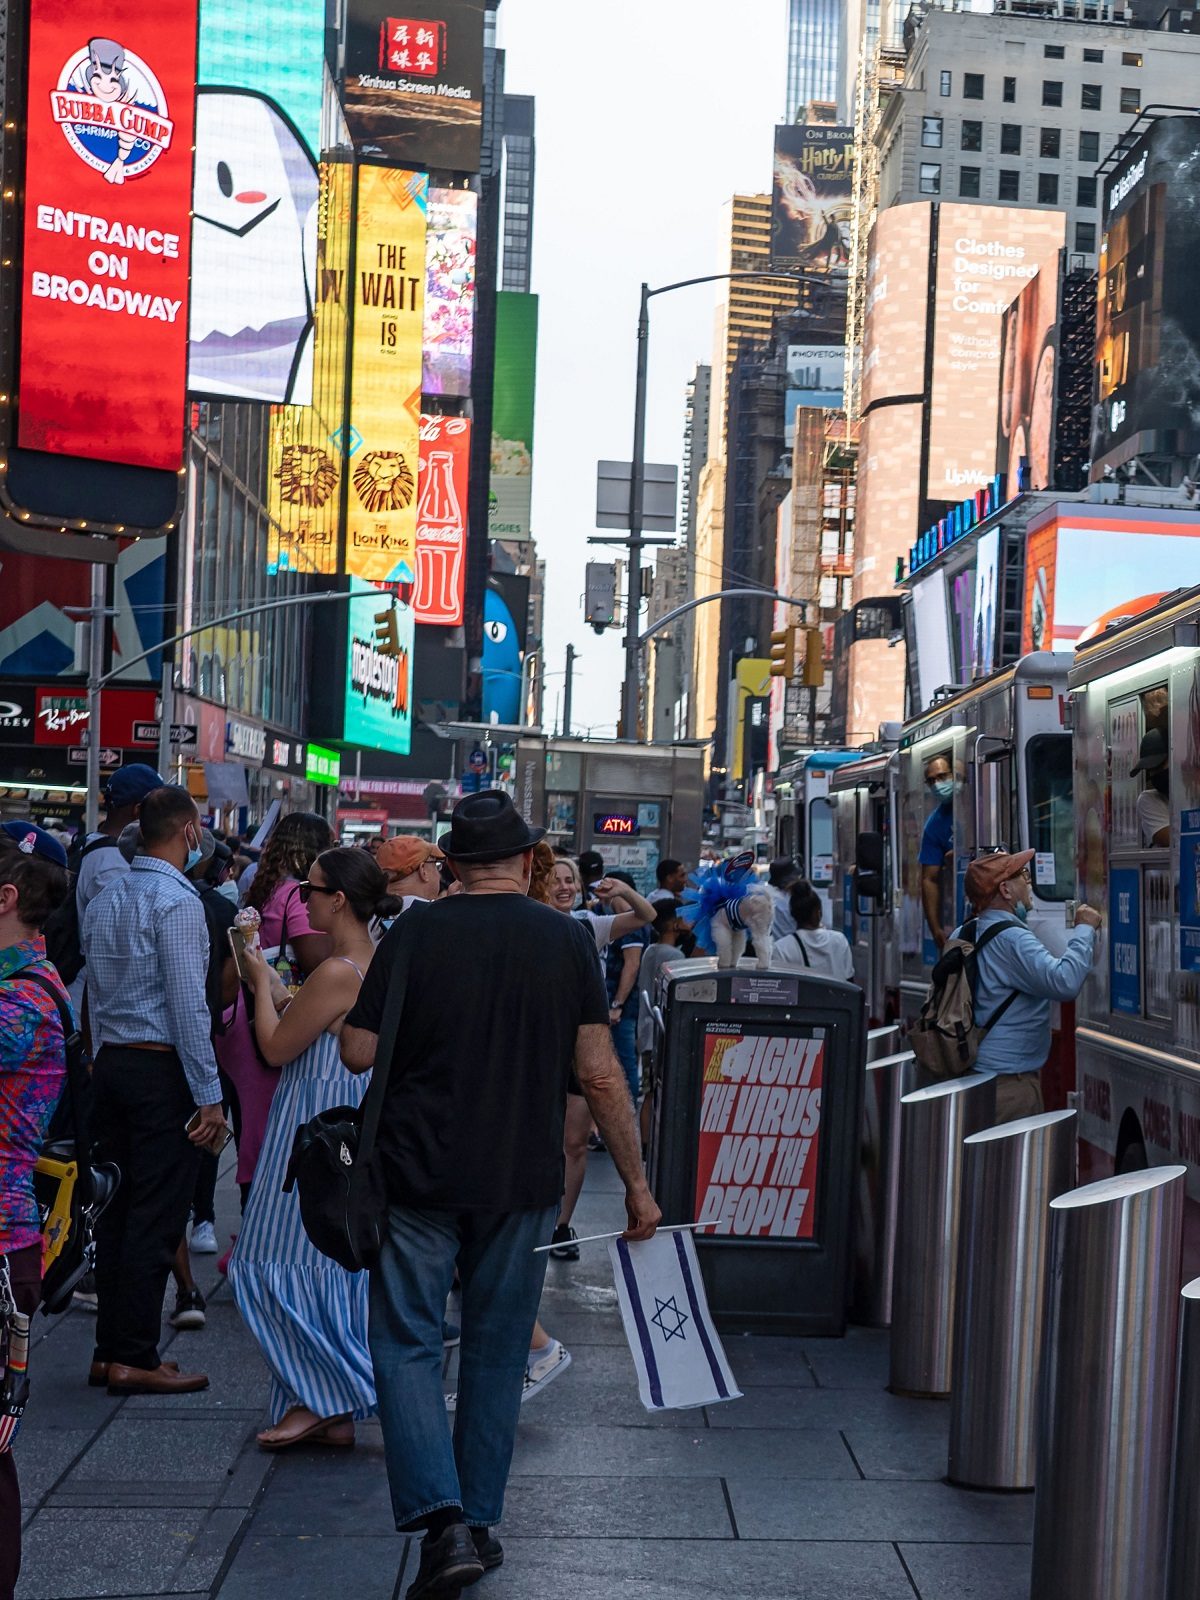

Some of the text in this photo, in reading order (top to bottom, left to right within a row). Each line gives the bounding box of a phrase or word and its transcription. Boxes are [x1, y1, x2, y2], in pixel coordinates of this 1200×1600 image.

[358, 74, 472, 99] Xinhua Screen Media
[56, 95, 169, 142] BUBBA GUMP
[74, 124, 118, 139] SHRIMP
[801, 147, 843, 175] Harry
[36, 204, 180, 259] ENTRANCE
[377, 243, 407, 271] THE
[954, 238, 1026, 259] Clothes
[87, 250, 129, 281] ON
[954, 257, 1039, 279] Designed
[31, 271, 183, 323] BROADWAY
[361, 271, 420, 312] WAIT
[953, 276, 981, 294] for
[381, 321, 397, 347] IS
[353, 531, 409, 549] LION KING
[522, 760, 537, 825] Newsstand
[603, 818, 632, 833] ATM
[730, 1035, 824, 1086] FIGHT
[700, 1083, 822, 1137] THE VIRUS
[710, 1135, 812, 1187] NOT THE
[694, 1184, 810, 1237] PEOPLE
